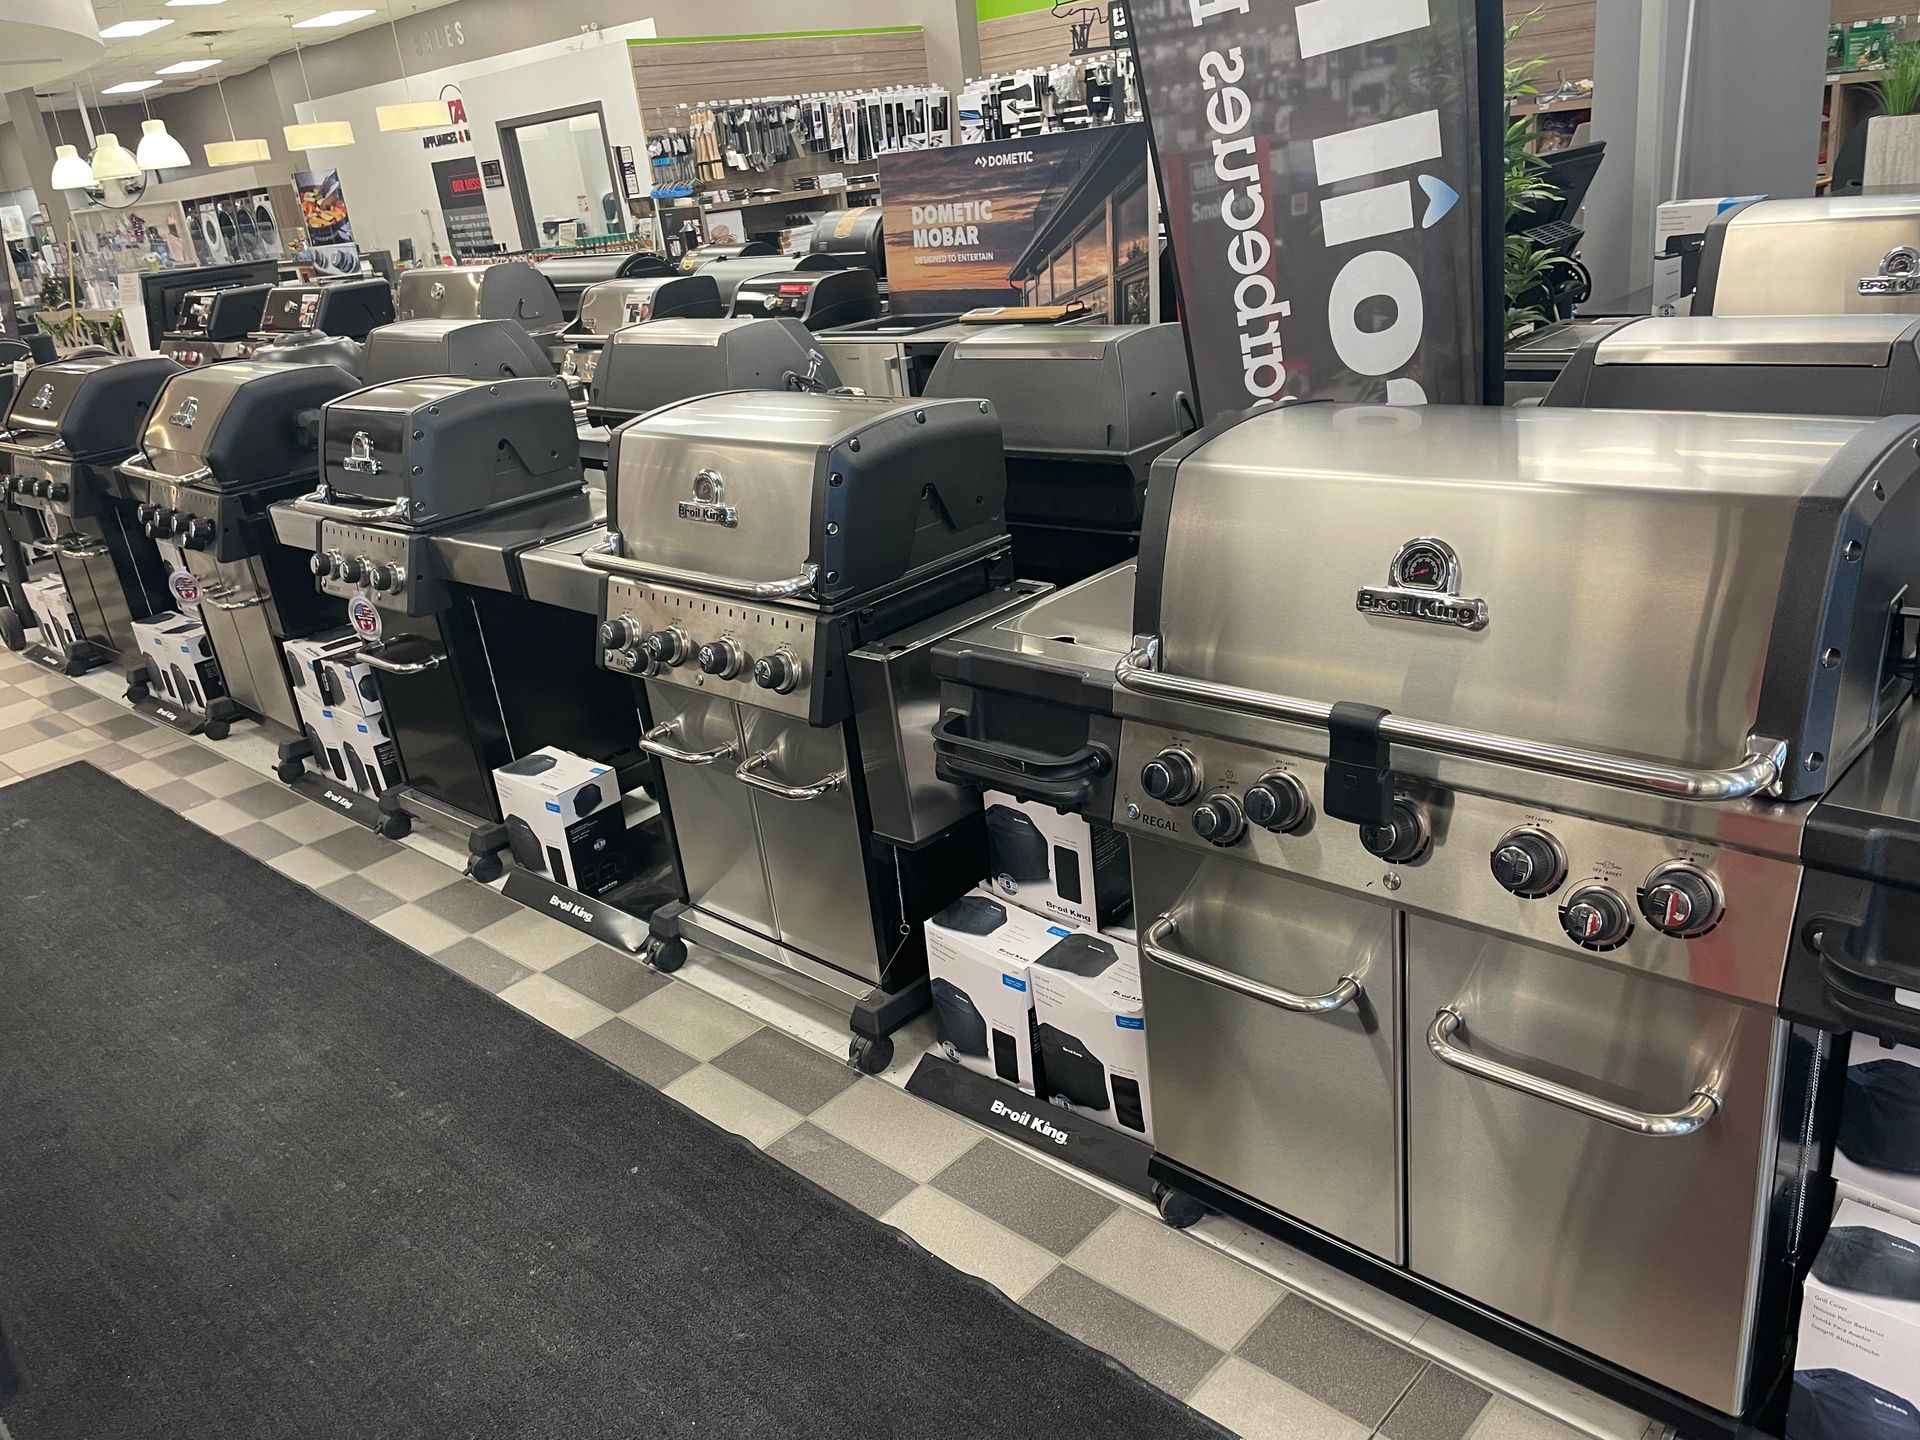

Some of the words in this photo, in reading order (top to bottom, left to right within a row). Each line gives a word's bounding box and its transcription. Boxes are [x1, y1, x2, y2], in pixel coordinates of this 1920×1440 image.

[988, 151, 1034, 167] DOMETIC
[911, 200, 993, 225] DOMETIC
[913, 225, 980, 248] MOBAR
[915, 253, 946, 264] DESIGNED
[948, 254, 957, 263] TO
[957, 252, 994, 263] ENTERTAIN
[678, 503, 701, 519] Broil
[702, 507, 728, 523] King
[1359, 592, 1413, 615] Broil
[1416, 597, 1478, 627] King
[1142, 814, 1179, 833] REGAL
[549, 894, 574, 913] Broil
[1045, 900, 1069, 914] Broil
[1069, 908, 1092, 923] King
[990, 1099, 1030, 1127] Broil
[1814, 1294, 1828, 1305] Grill
[1829, 1300, 1848, 1312] Cover
